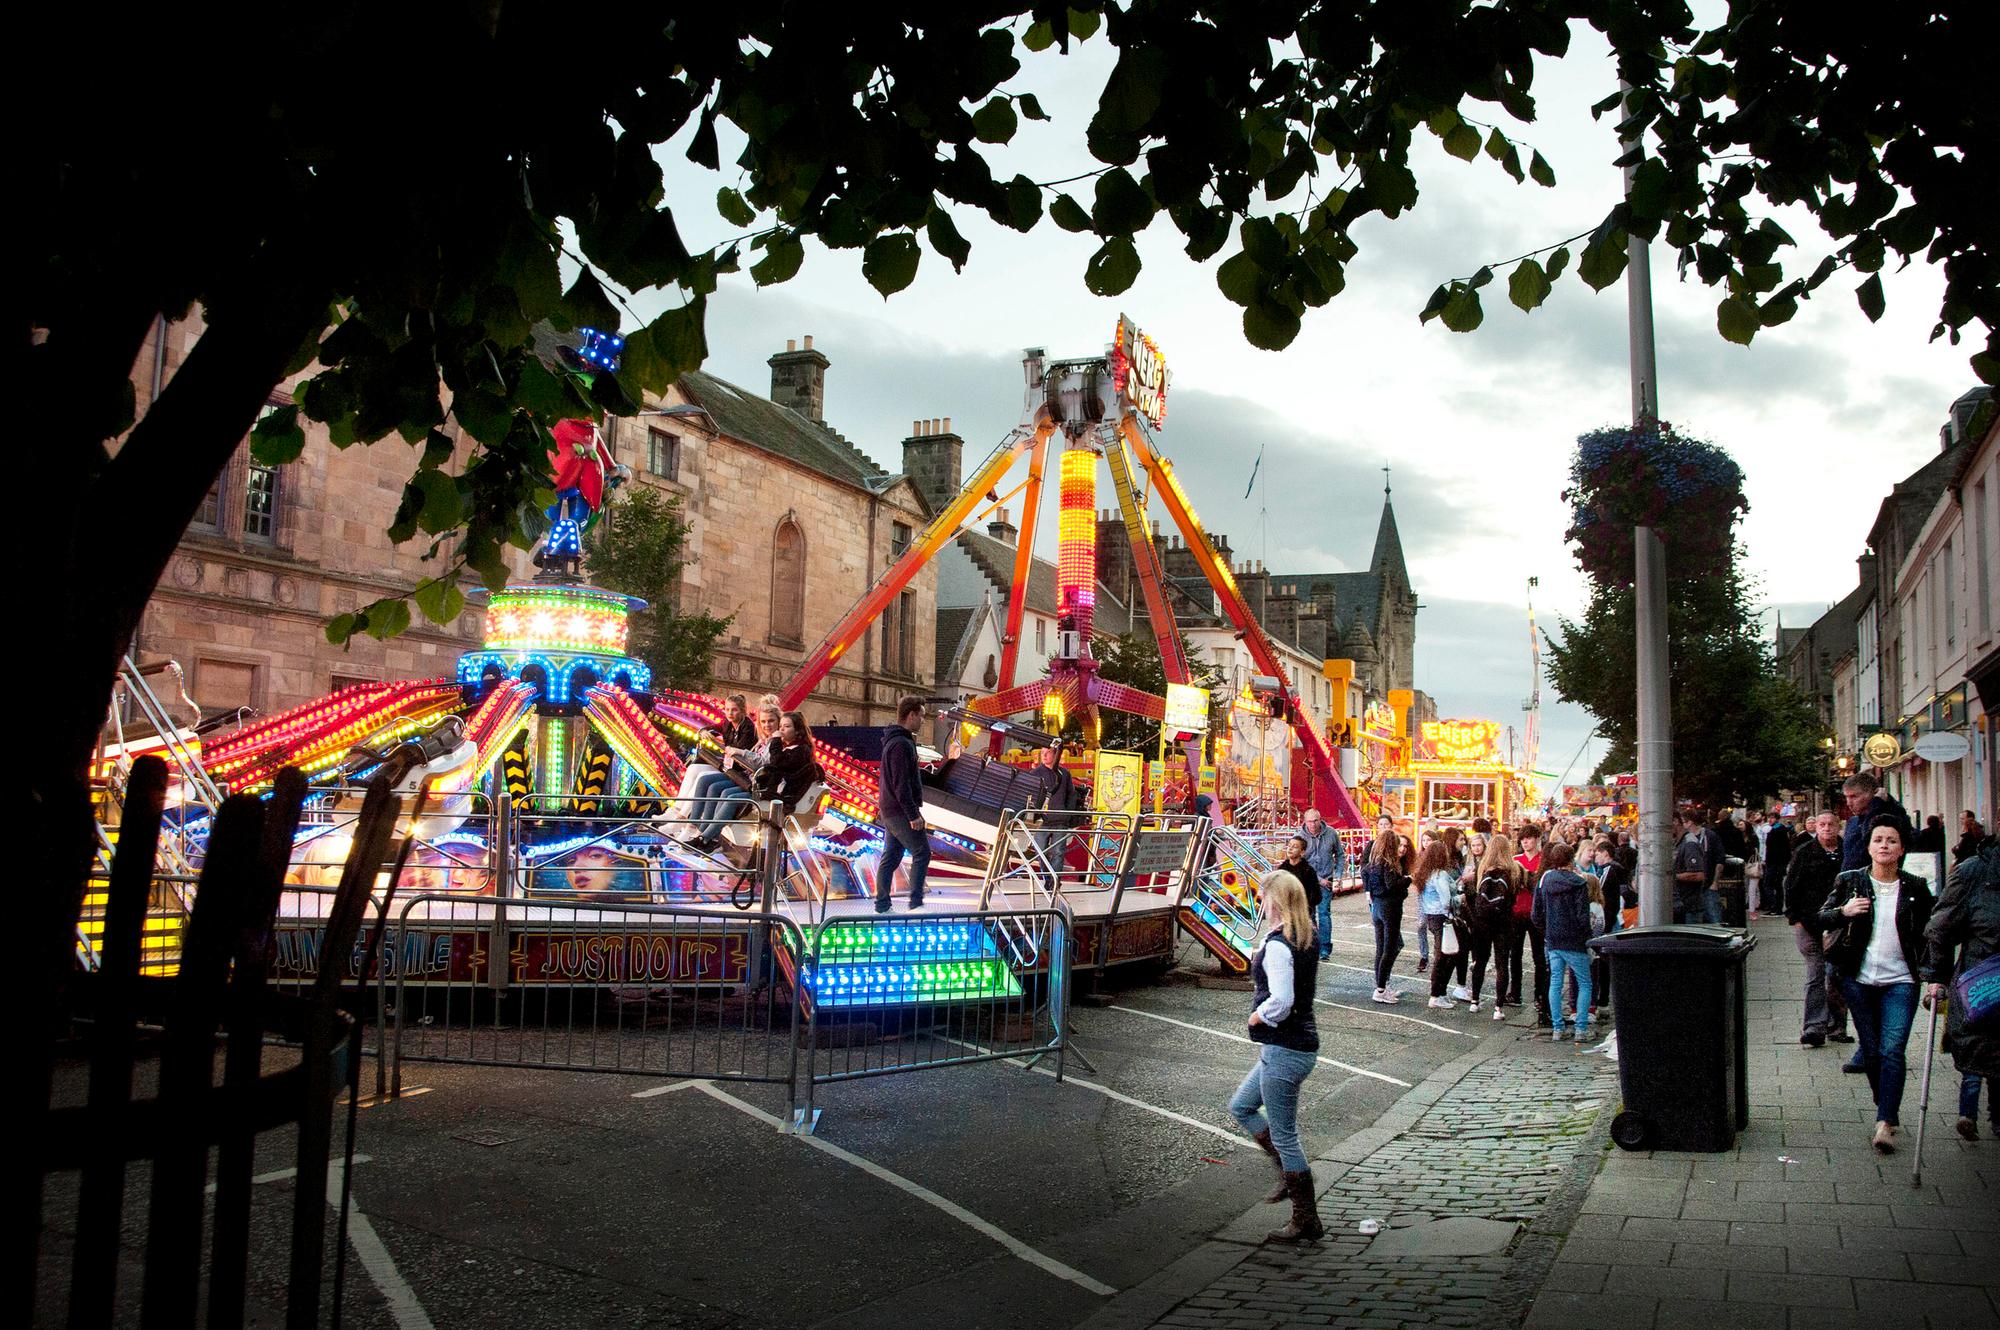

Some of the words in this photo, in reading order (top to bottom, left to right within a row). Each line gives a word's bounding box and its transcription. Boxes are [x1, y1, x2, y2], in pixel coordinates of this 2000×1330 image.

[1421, 721, 1501, 745] ENERGY
[409, 781, 416, 790] 5
[541, 936, 624, 981] JUST
[630, 936, 671, 981] DO
[680, 940, 717, 977] IT
